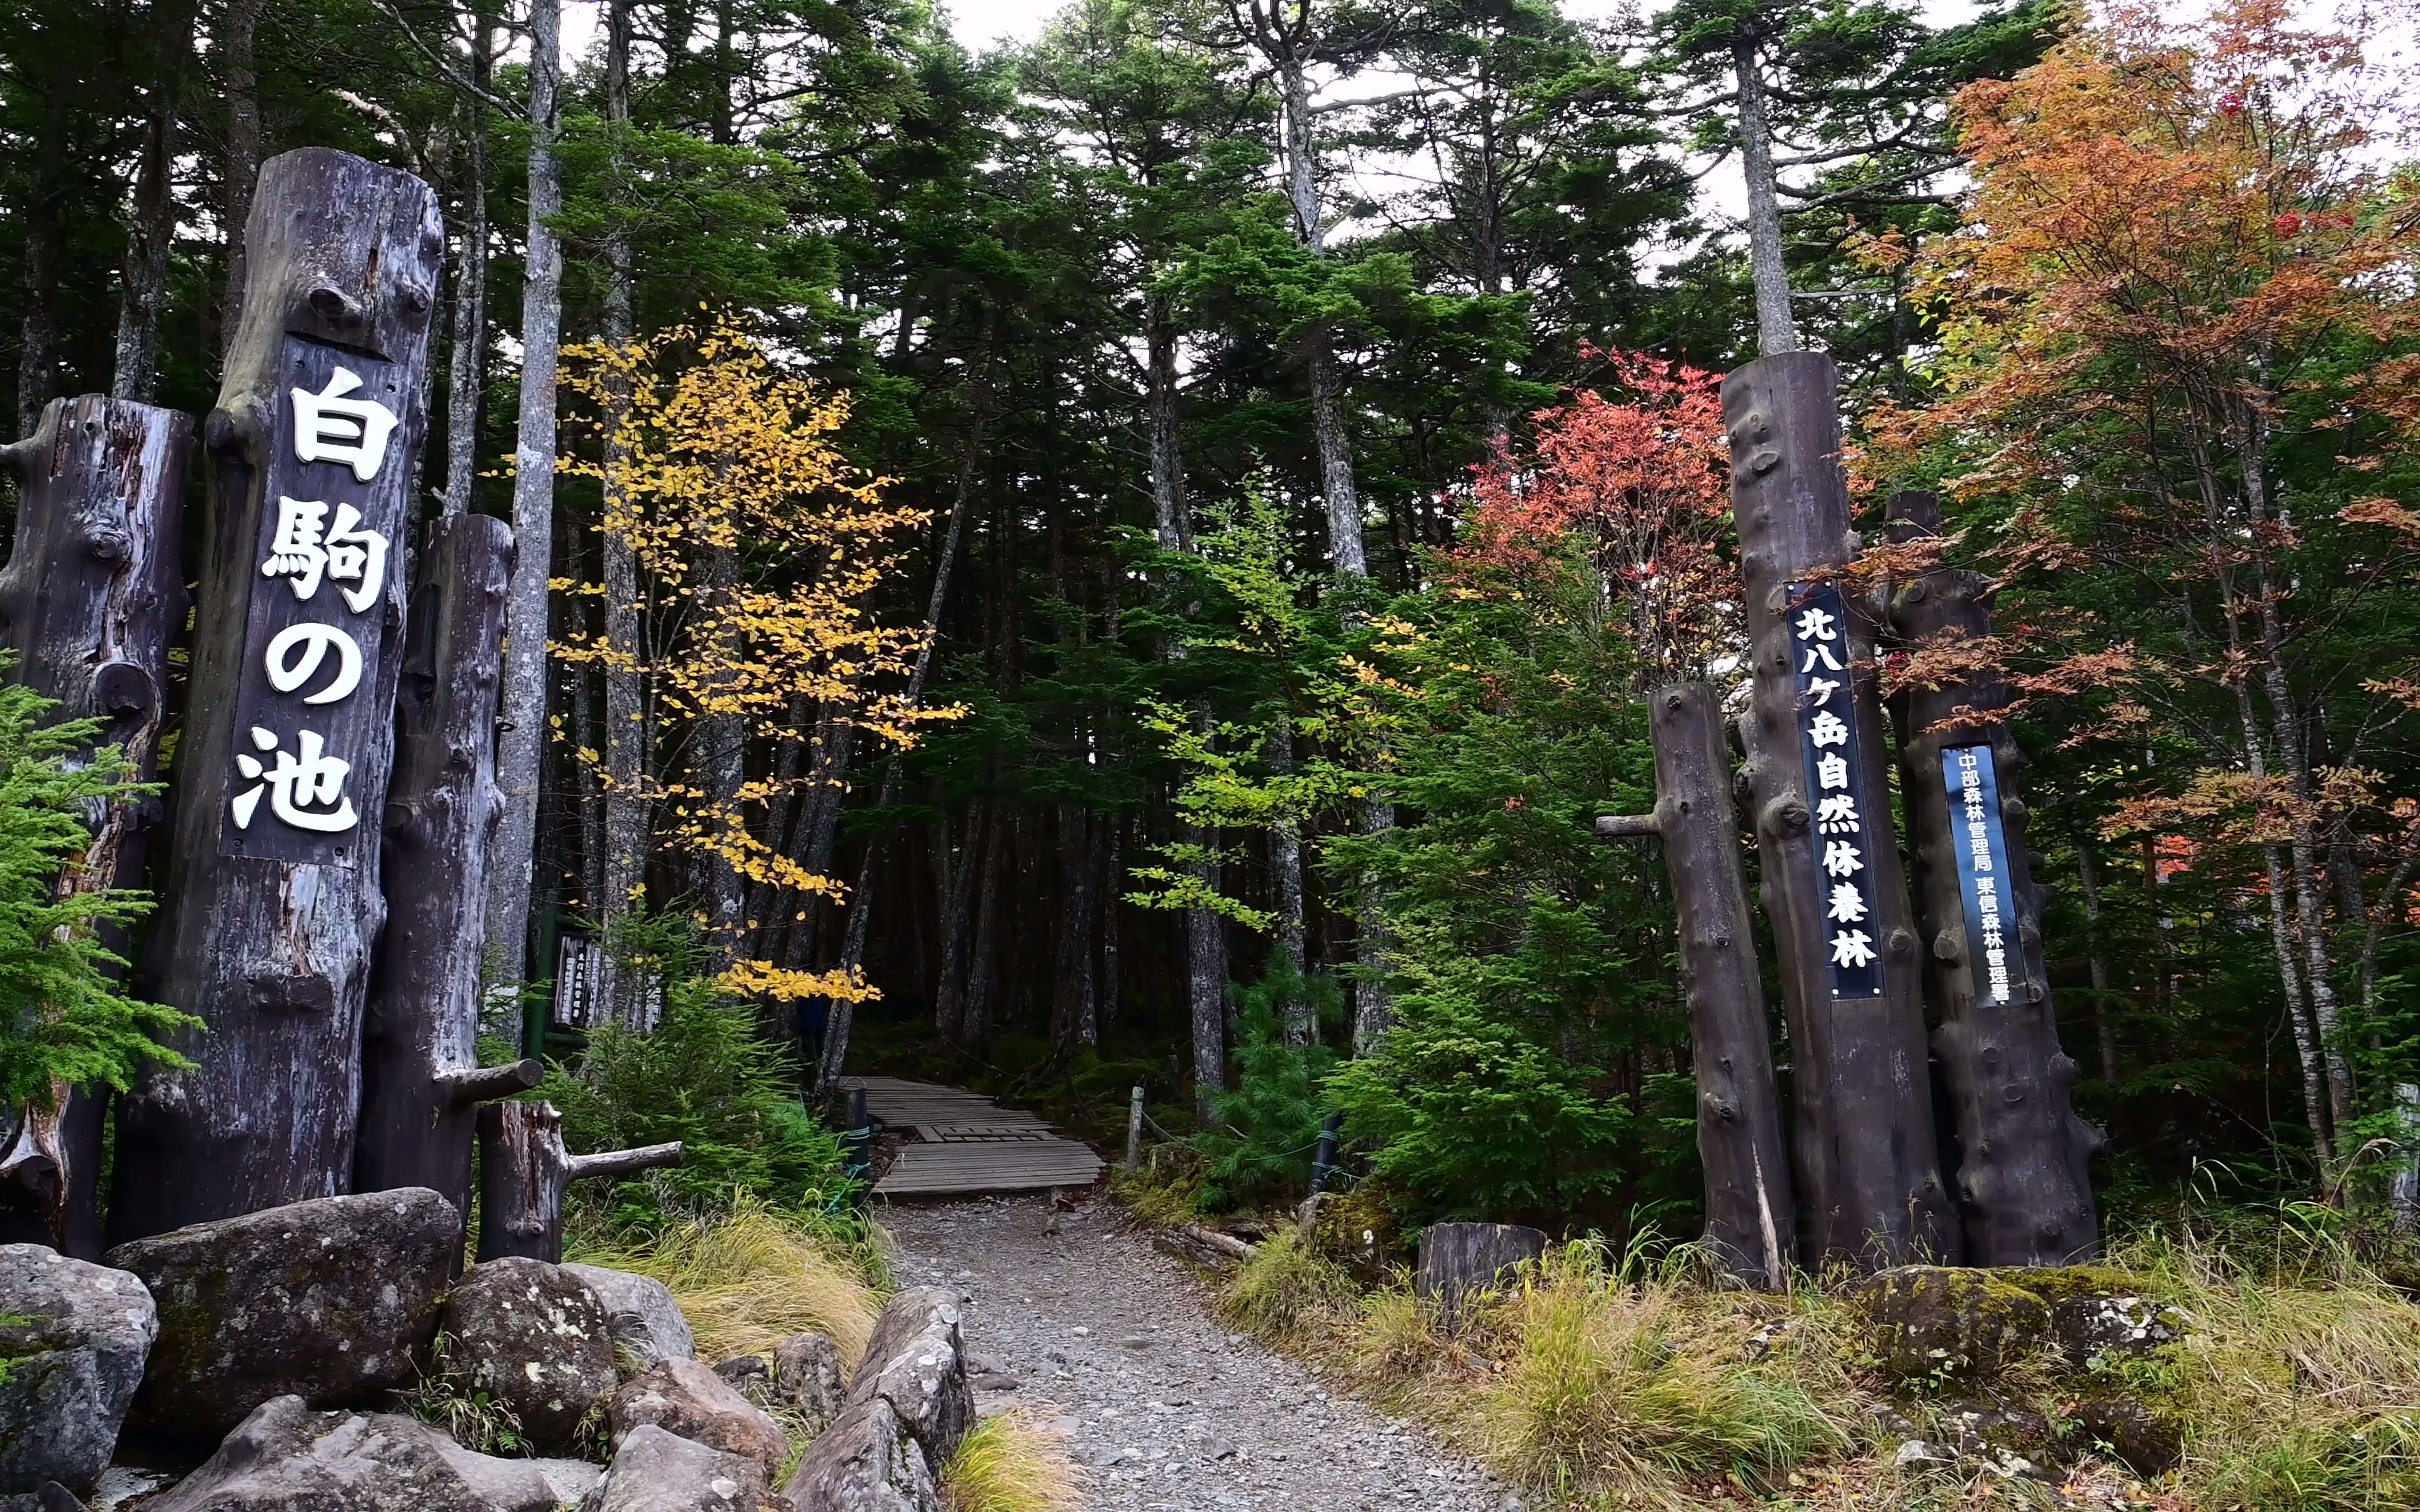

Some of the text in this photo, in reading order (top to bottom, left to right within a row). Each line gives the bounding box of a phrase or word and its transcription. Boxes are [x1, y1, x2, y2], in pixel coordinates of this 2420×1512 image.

[232, 366, 398, 832] 白駒の池
[1958, 753, 2010, 1002] 中部森林管理局 東信森林管理署
